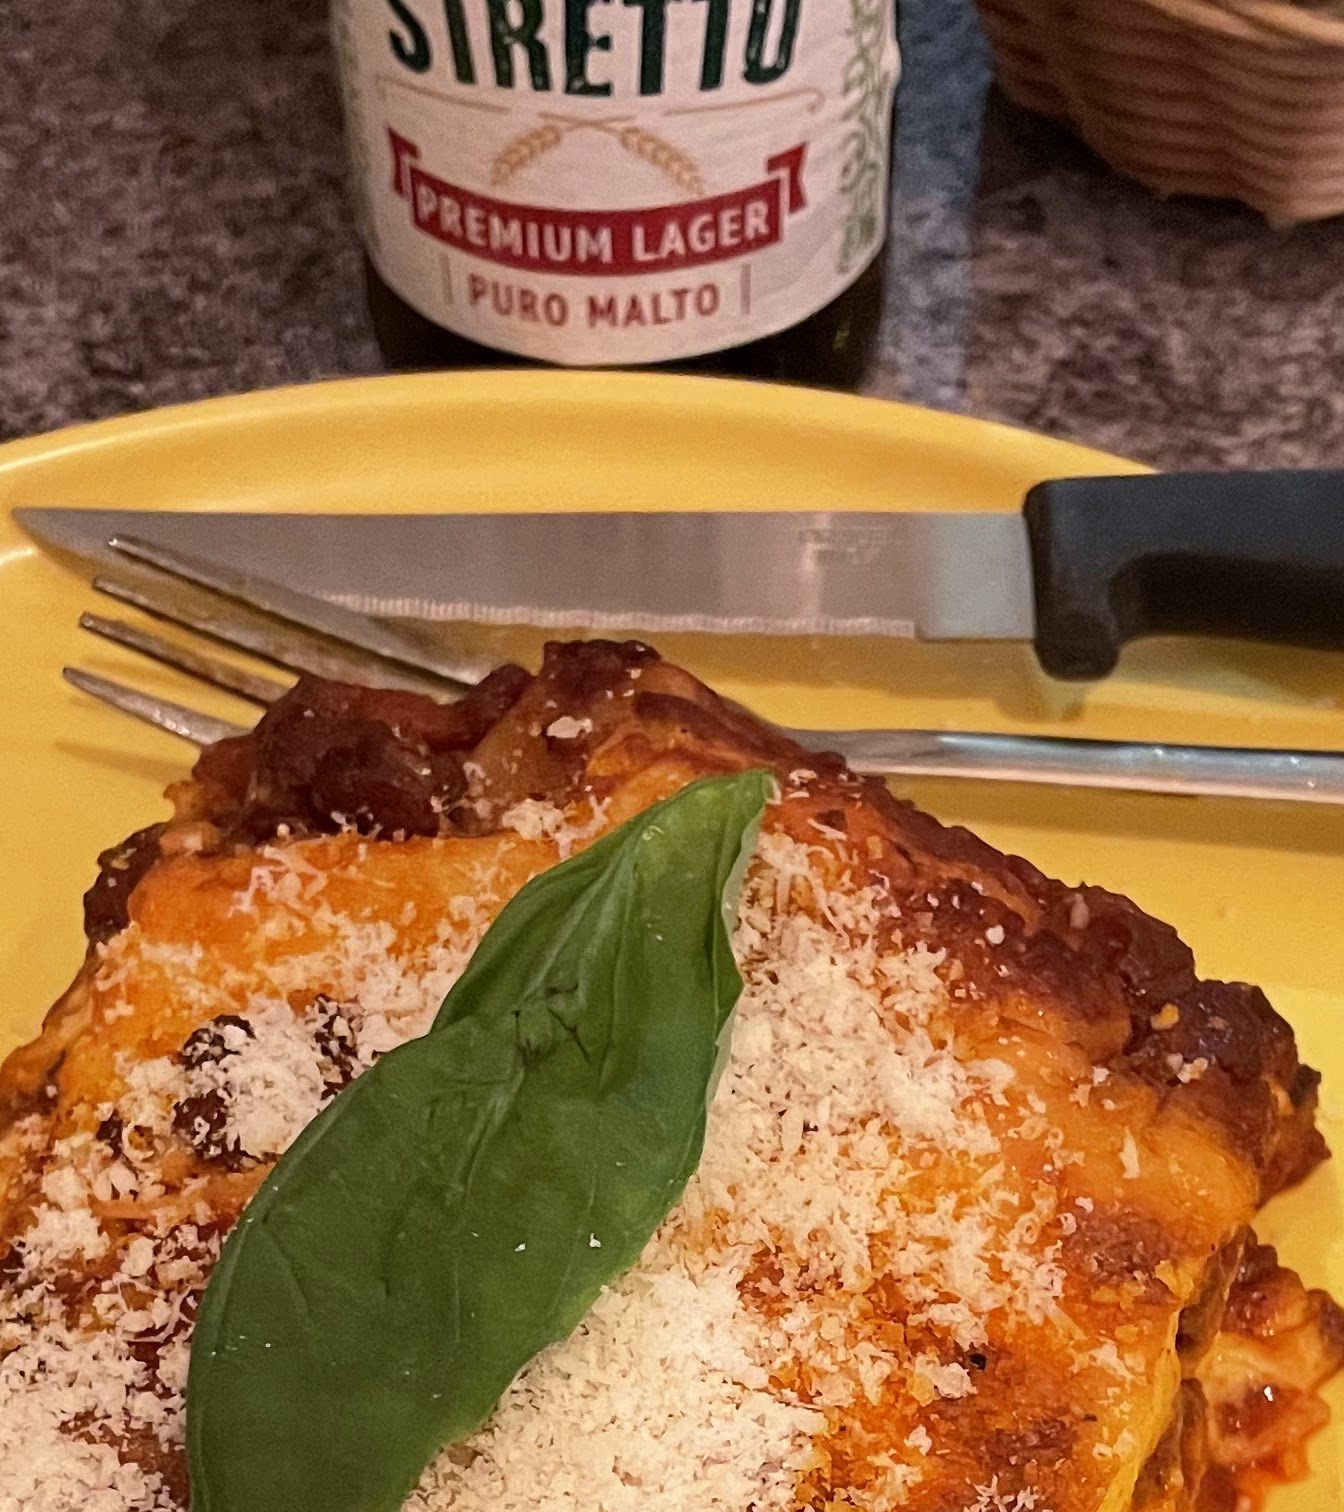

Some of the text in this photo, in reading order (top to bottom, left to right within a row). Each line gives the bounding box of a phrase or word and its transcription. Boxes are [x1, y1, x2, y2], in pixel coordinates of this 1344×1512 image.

[415, 184, 771, 265] PREMIUM LAGER
[467, 272, 721, 329] PURO MALTO
